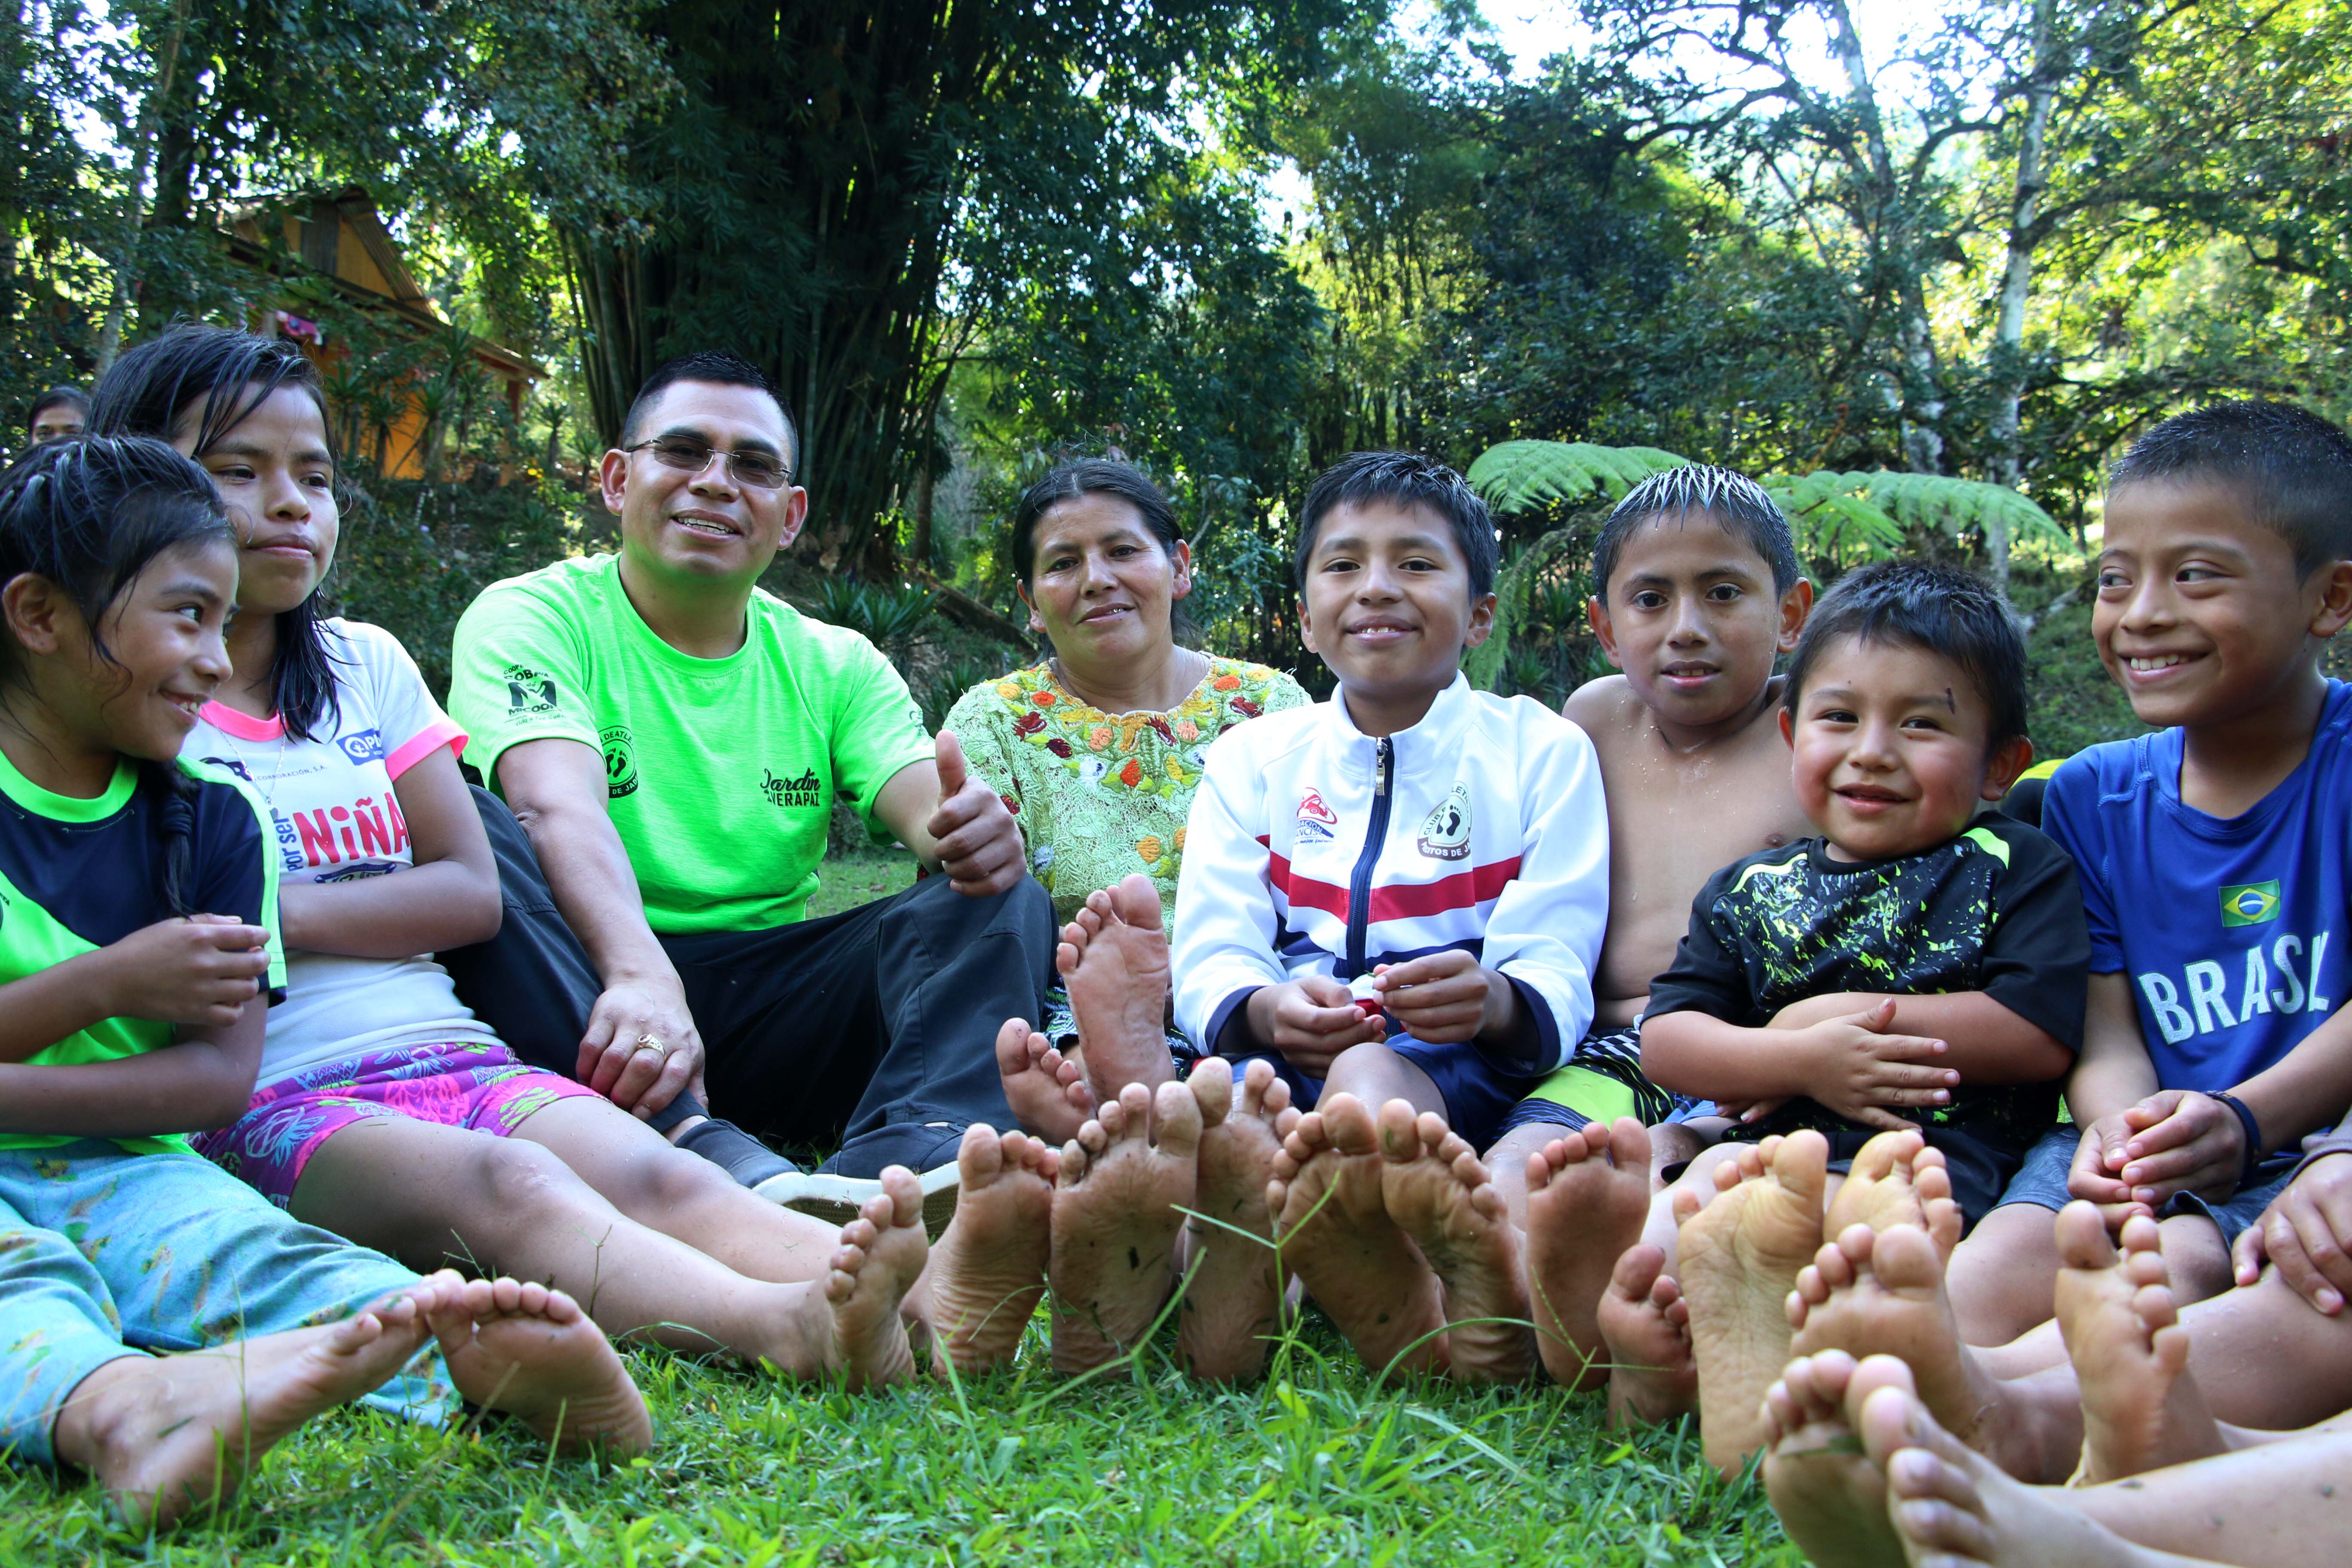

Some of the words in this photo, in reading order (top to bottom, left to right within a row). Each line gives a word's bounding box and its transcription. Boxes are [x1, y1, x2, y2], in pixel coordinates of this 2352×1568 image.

[1424, 814, 1441, 835] CLUB
[280, 848, 304, 872] por
[1451, 848, 1462, 857] DE
